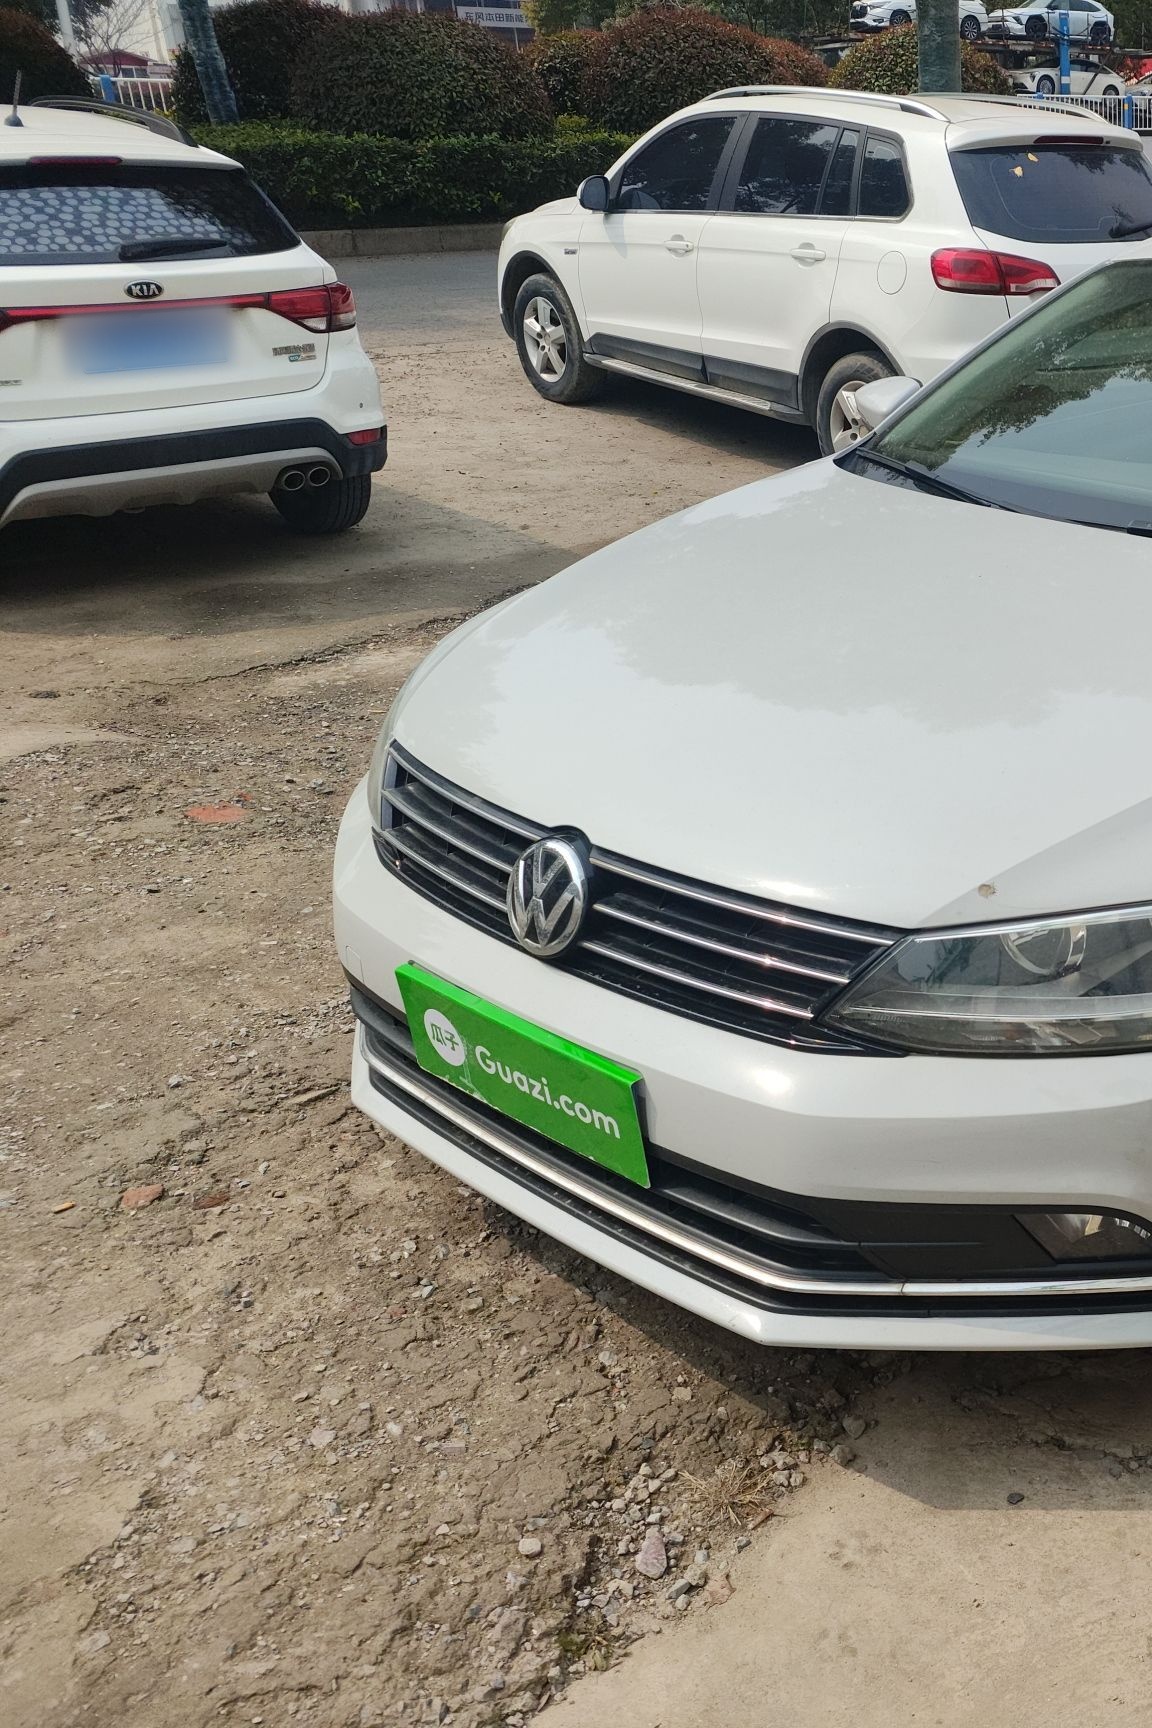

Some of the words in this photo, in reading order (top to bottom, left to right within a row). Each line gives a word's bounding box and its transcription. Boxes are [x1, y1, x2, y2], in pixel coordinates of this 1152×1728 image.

[465, 11, 528, 23] 东风本田新能
[131, 283, 160, 296] KIA
[430, 1022, 460, 1052] 瓜子
[475, 1045, 621, 1139] Guazi.com
